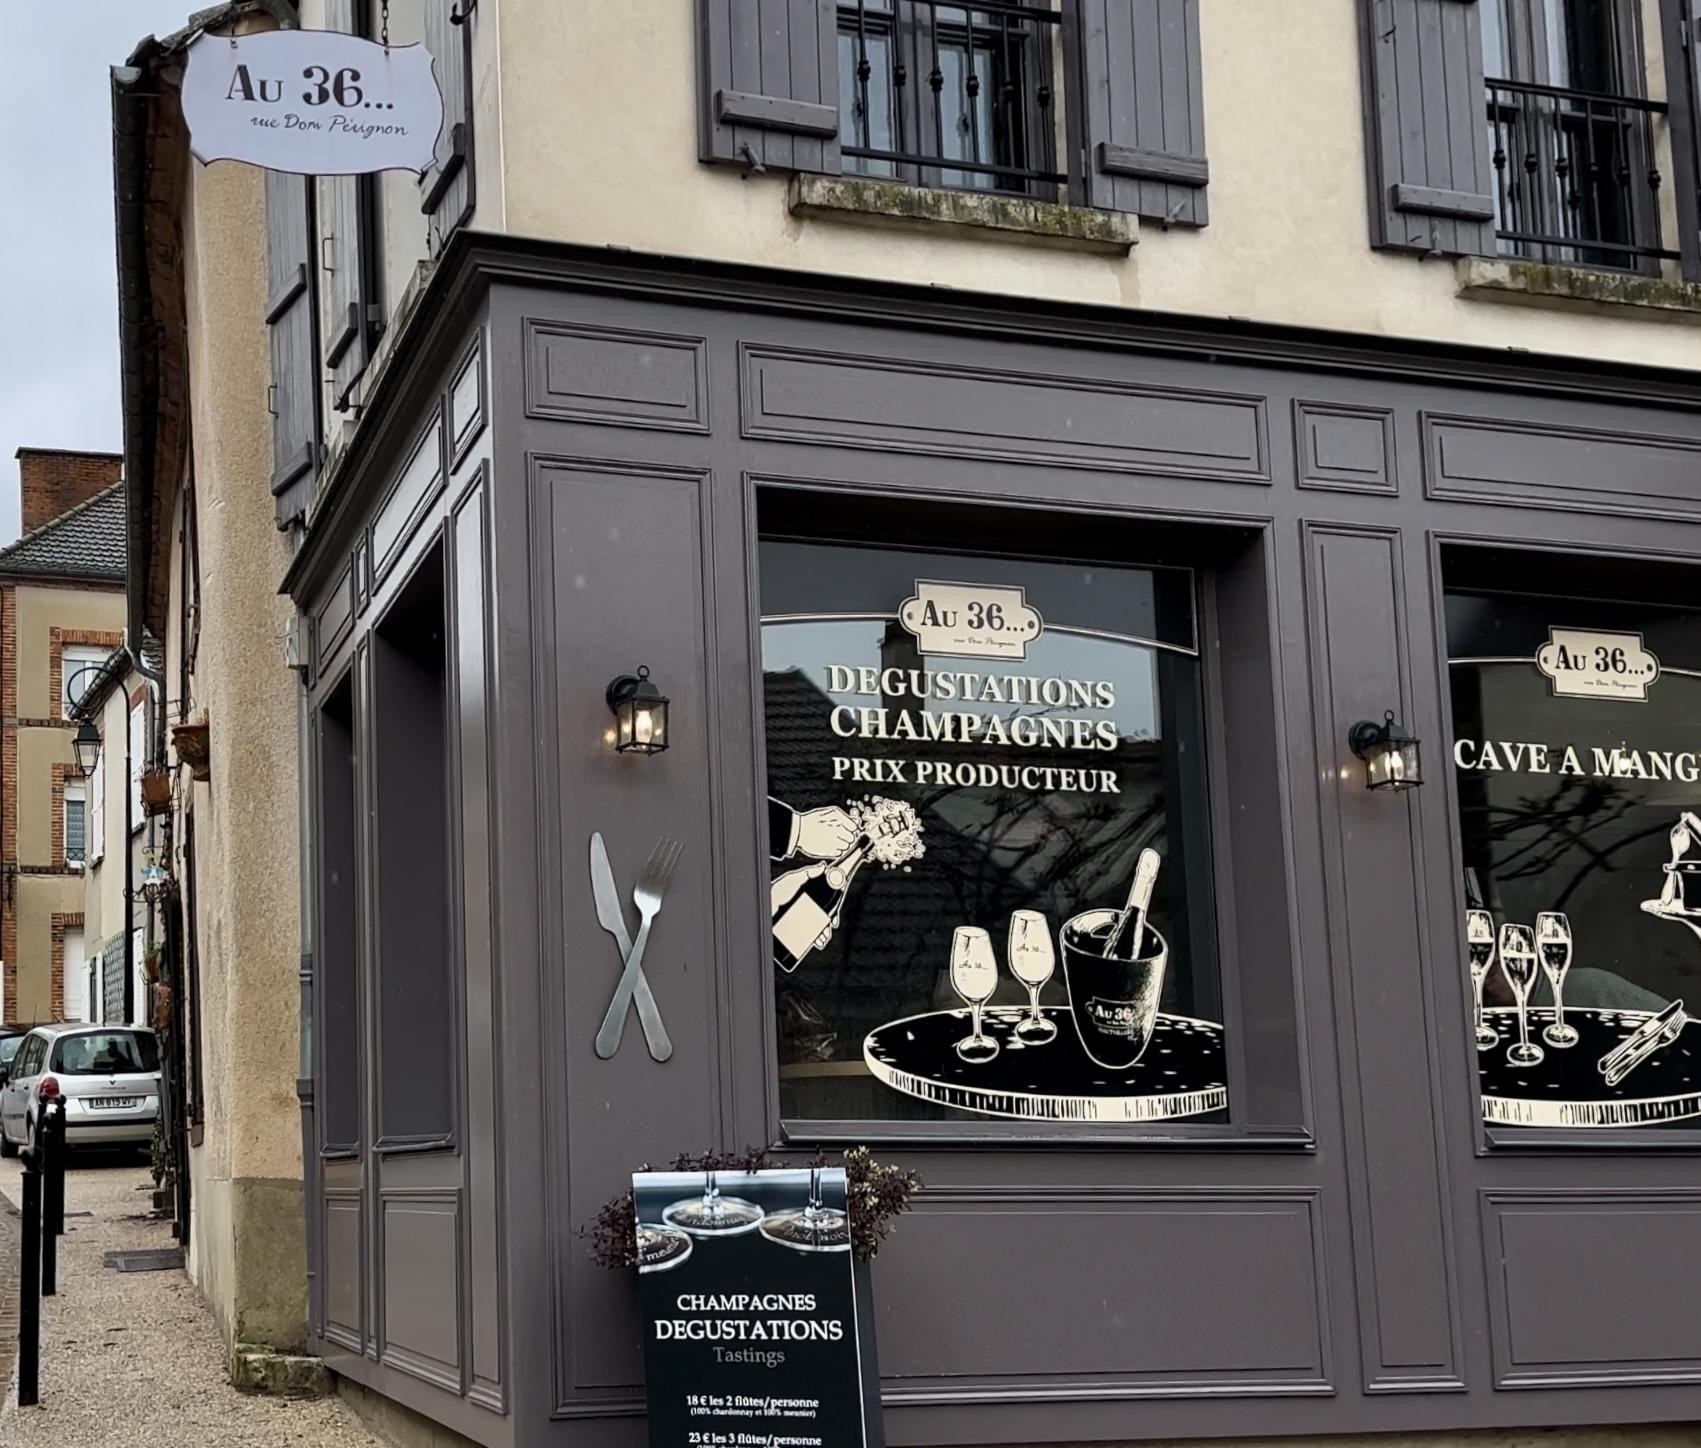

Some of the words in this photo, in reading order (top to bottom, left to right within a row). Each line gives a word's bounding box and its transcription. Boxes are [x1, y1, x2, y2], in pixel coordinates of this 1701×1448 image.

[302, 65, 394, 110] 36...
[250, 115, 280, 128] rue
[284, 113, 322, 131] Dom
[967, 601, 1025, 632] 36...
[1594, 646, 1644, 675] 36...
[828, 664, 1116, 709] DEGUSTATIONS
[830, 705, 1118, 751] CHAMPAGNES
[831, 757, 907, 783] PRIX
[915, 760, 1120, 793] PRODUCTEUR
[1453, 739, 1550, 773] CAVE
[1559, 745, 1585, 775] A
[1591, 747, 1701, 782] MANG
[677, 1294, 816, 1311] CHAMPAGNES
[654, 1320, 843, 1340] DEGUSTATIONS
[713, 1347, 785, 1367] Tastings
[686, 1395, 699, 1406] 18
[709, 1395, 724, 1406] les
[726, 1395, 733, 1406] 2
[688, 1432, 700, 1443] 23
[702, 1432, 710, 1443] €
[711, 1432, 727, 1443] les
[728, 1433, 735, 1444] 3
